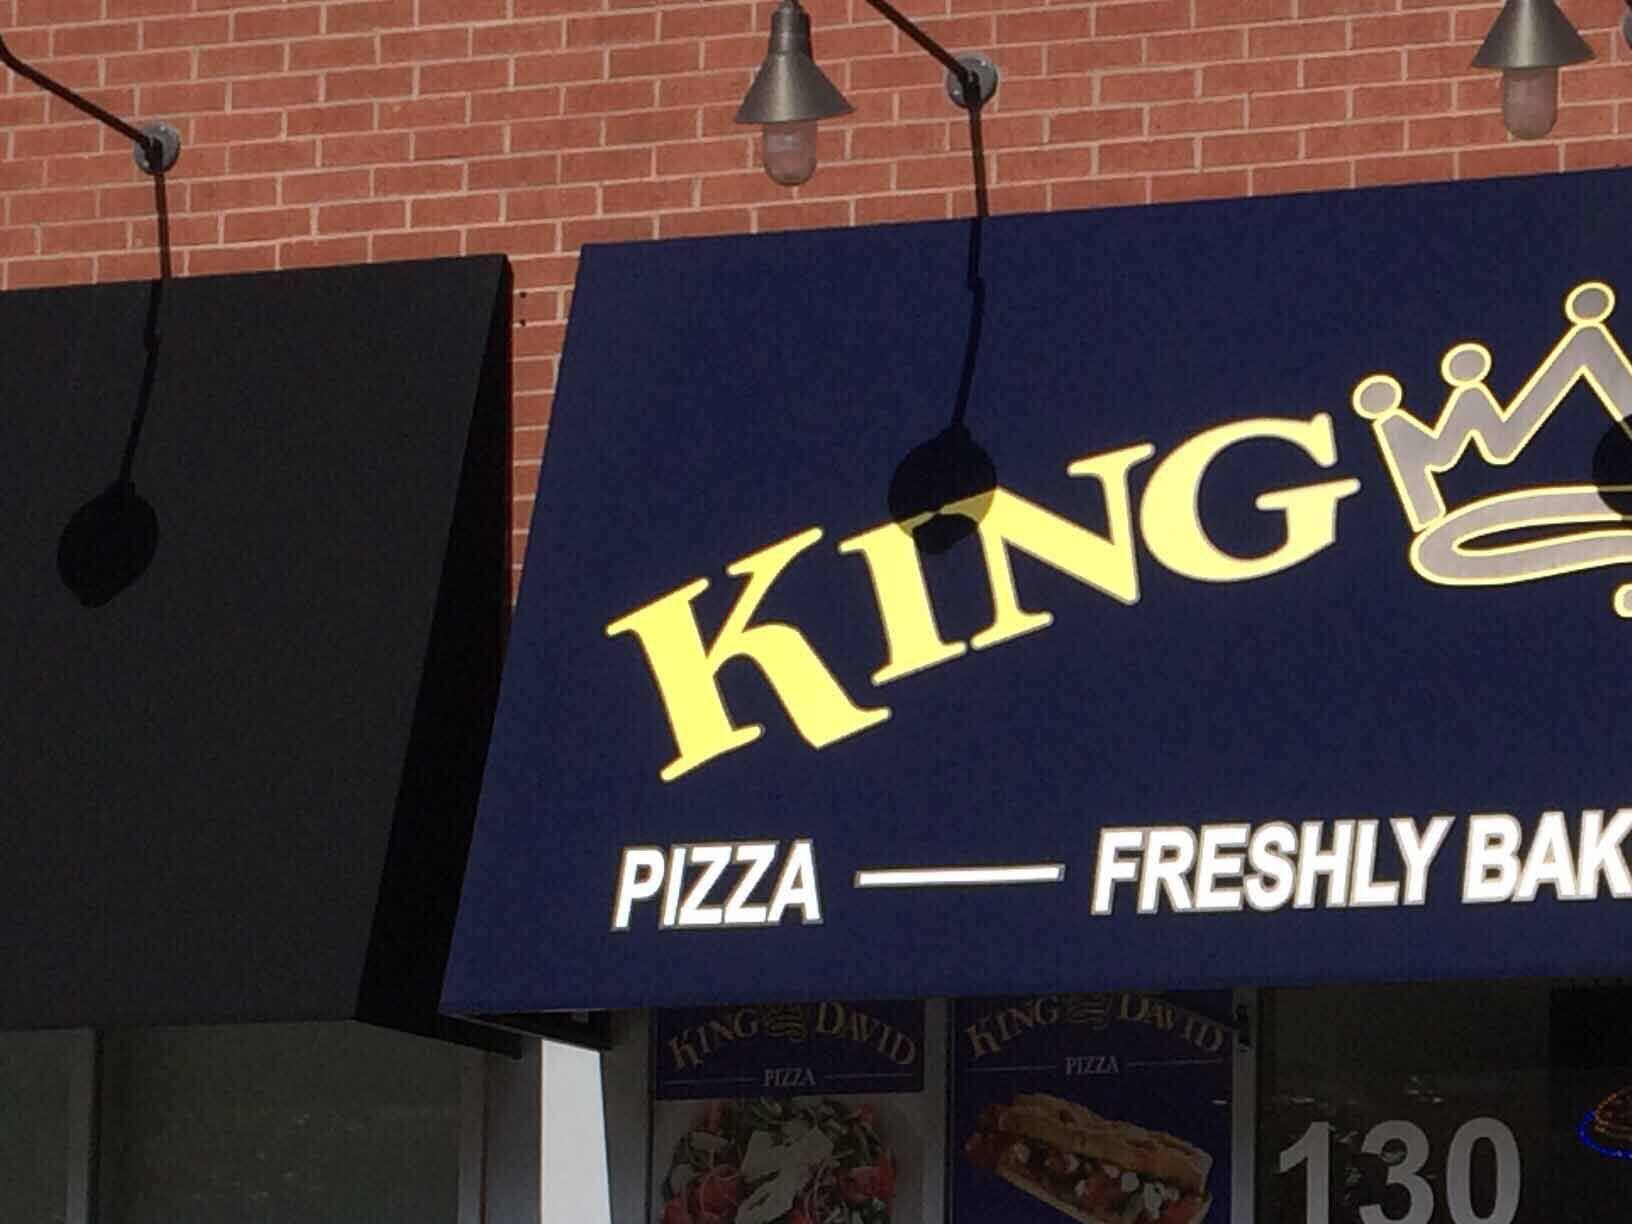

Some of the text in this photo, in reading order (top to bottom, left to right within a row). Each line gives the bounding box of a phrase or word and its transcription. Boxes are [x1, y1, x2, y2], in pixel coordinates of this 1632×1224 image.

[605, 412, 1361, 783] KING
[611, 839, 823, 931] PIZZA
[1091, 816, 1455, 915] FRESHLY
[668, 1001, 918, 1072] KING DAVID
[965, 993, 1225, 1059] KING DAVID
[763, 1067, 817, 1089] PIZZA
[1064, 1055, 1120, 1076] PIZZA
